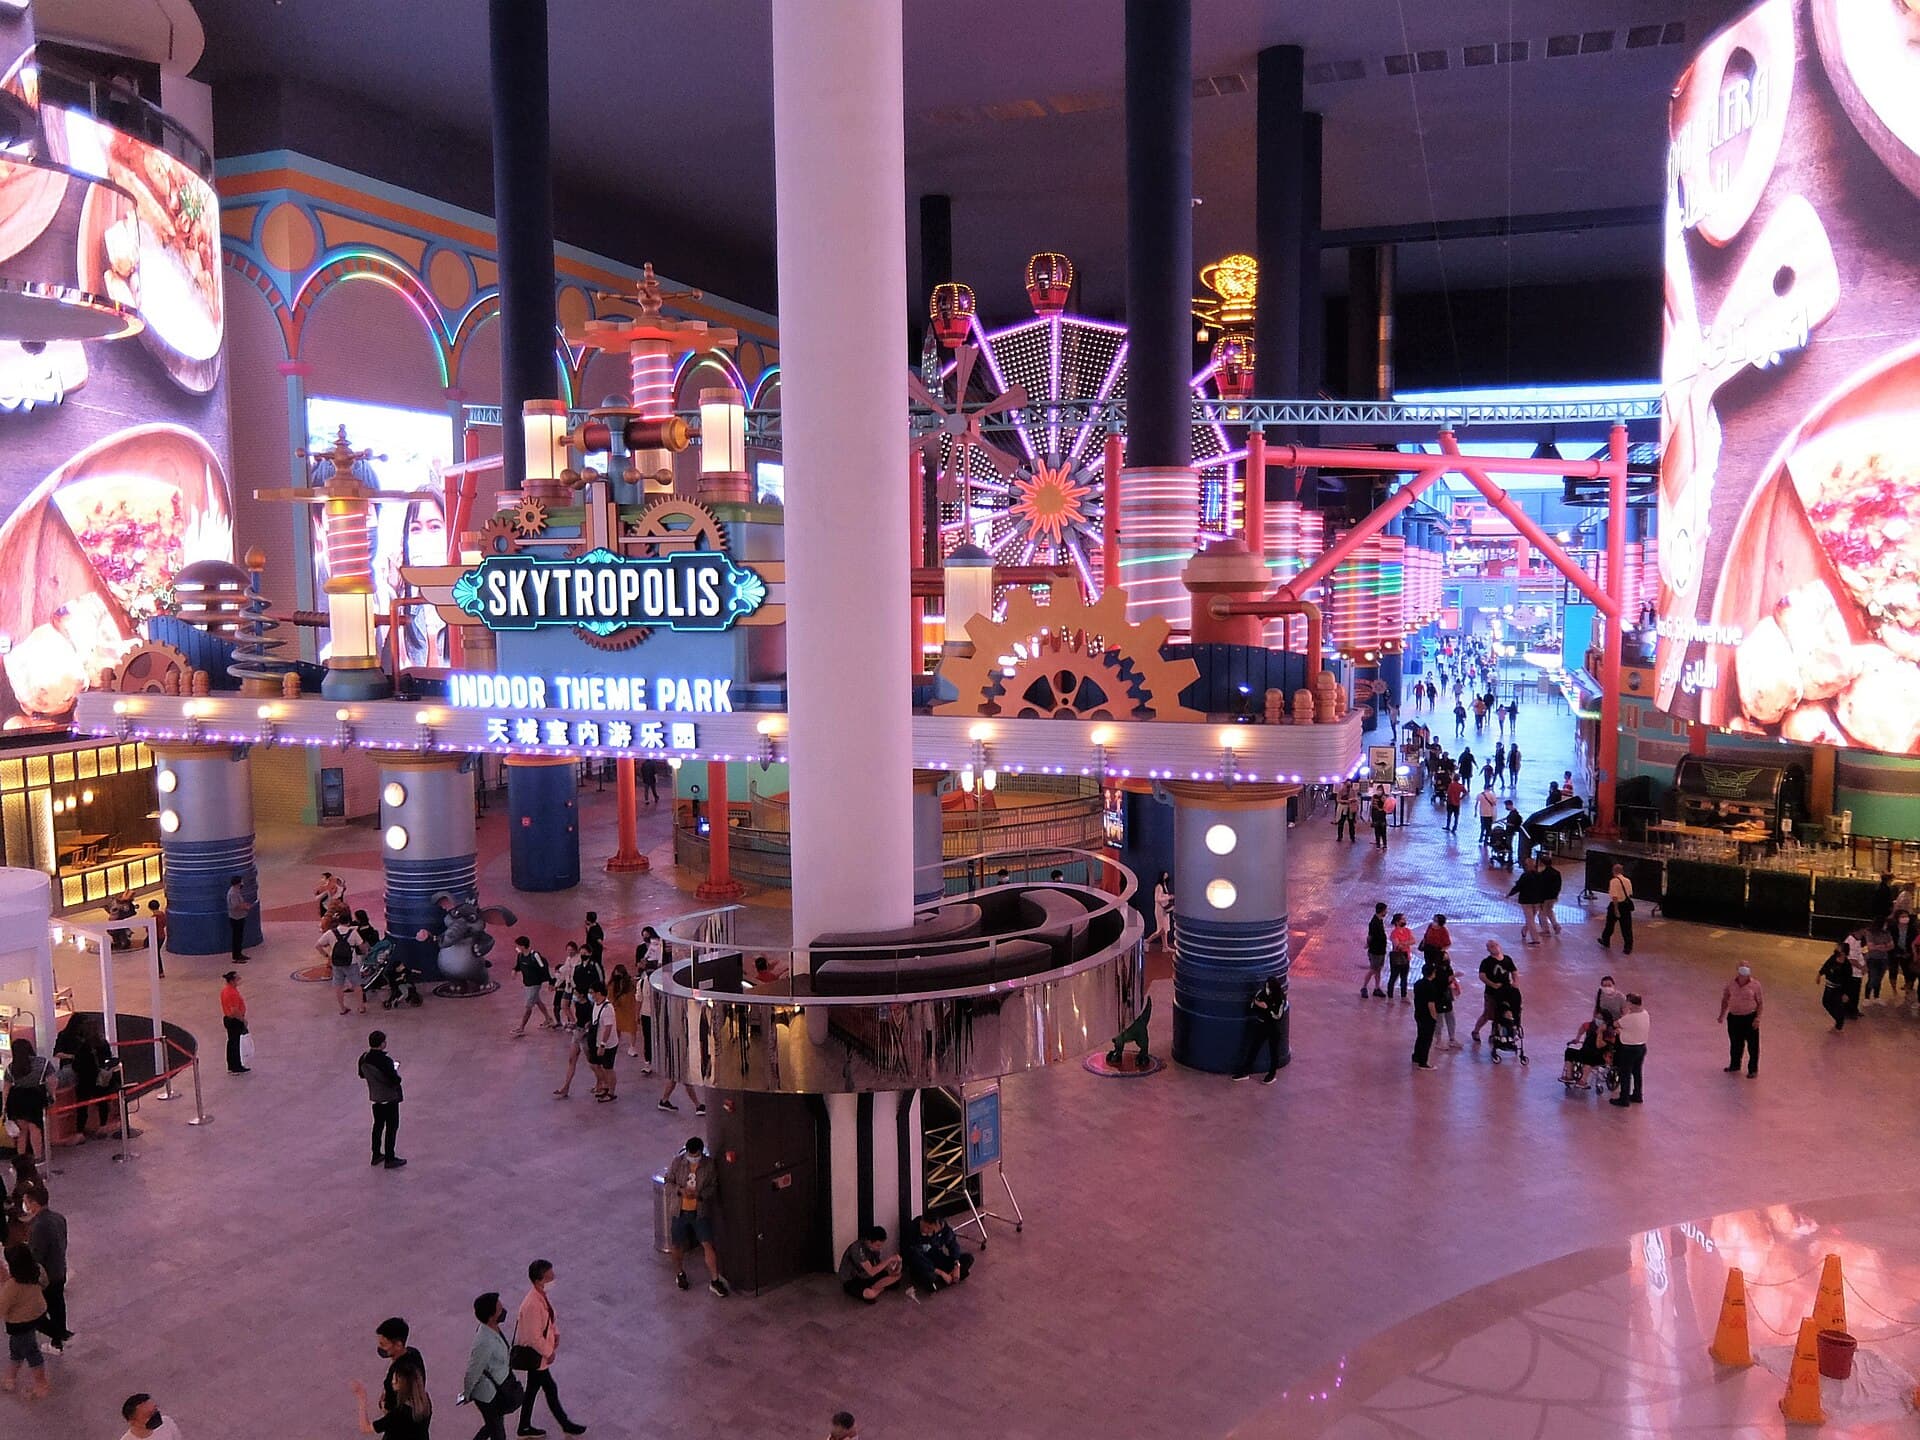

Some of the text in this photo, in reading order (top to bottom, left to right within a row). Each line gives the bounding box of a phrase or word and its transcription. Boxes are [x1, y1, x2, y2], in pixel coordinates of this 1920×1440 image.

[488, 568, 720, 617] SKYTROPOLIS
[451, 674, 733, 712] INDOOR THEME PARK
[487, 718, 696, 749] 天城室内游乐园
